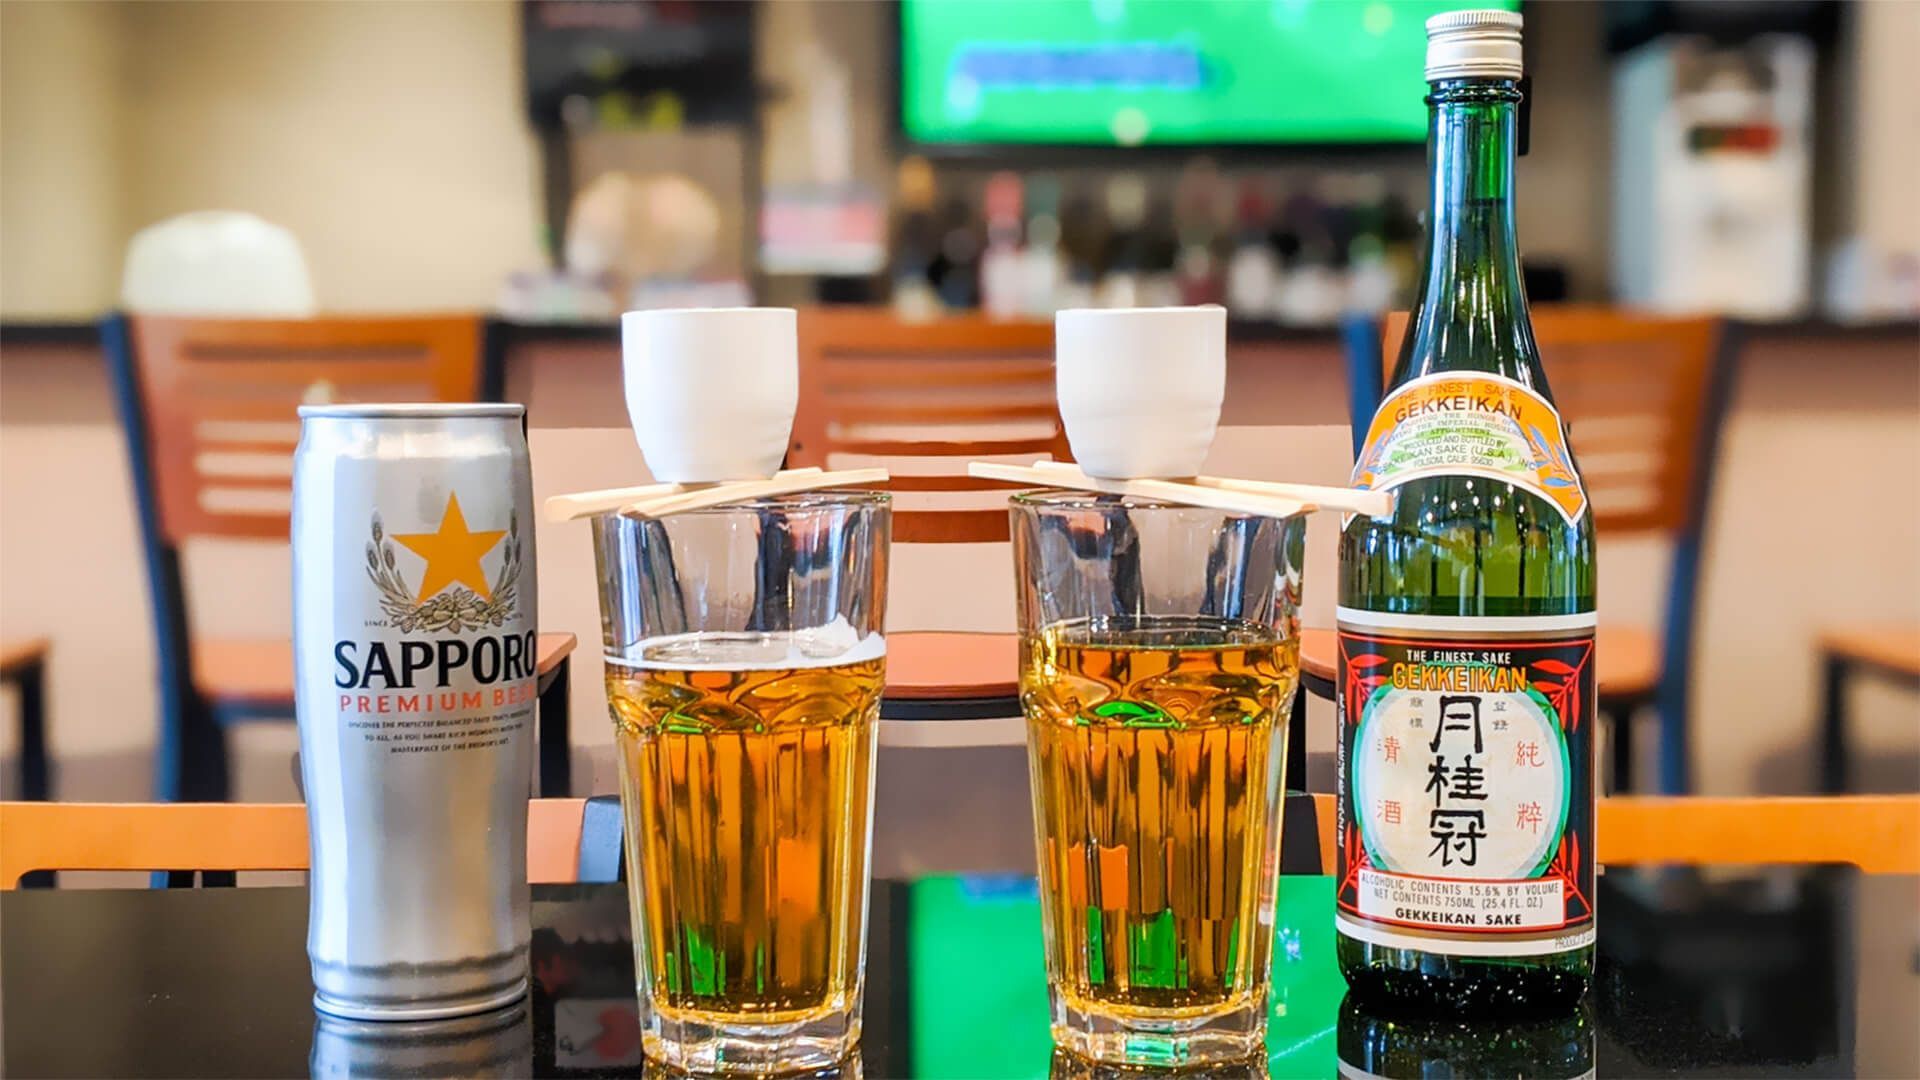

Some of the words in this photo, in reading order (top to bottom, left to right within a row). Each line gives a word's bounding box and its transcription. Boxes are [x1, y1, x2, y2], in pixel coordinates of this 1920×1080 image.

[1428, 382, 1472, 396] FINEST
[1484, 384, 1517, 400] SAKE
[1394, 395, 1522, 424] GEKKEIKAN
[1404, 437, 1441, 450] PRODUCED
[1444, 435, 1460, 444] AND
[1461, 436, 1496, 447] BOTTLED
[1435, 445, 1467, 454] SAKE
[334, 629, 537, 690] SAPPORO
[1406, 649, 1428, 663] THE
[1433, 651, 1475, 664] FINEST
[1481, 652, 1512, 665] SAKE
[1392, 662, 1528, 692] GEKKEIKAN
[340, 690, 483, 713] PREMIUM
[1424, 694, 1490, 867] 月桂冠
[1361, 872, 1406, 890] ALCOHOLIC
[1410, 880, 1462, 896] CONTENTS
[1469, 885, 1501, 897] 15.6%
[1506, 886, 1520, 897] BY
[1525, 882, 1559, 895] VOLUME
[1373, 887, 1389, 900] NET
[1392, 890, 1442, 907] CONTENTS
[1444, 895, 1476, 909] 750ML
[1481, 896, 1507, 910] (25.4
[1394, 906, 1476, 926] GEKKEIKAN
[1485, 913, 1522, 926] SAKE
